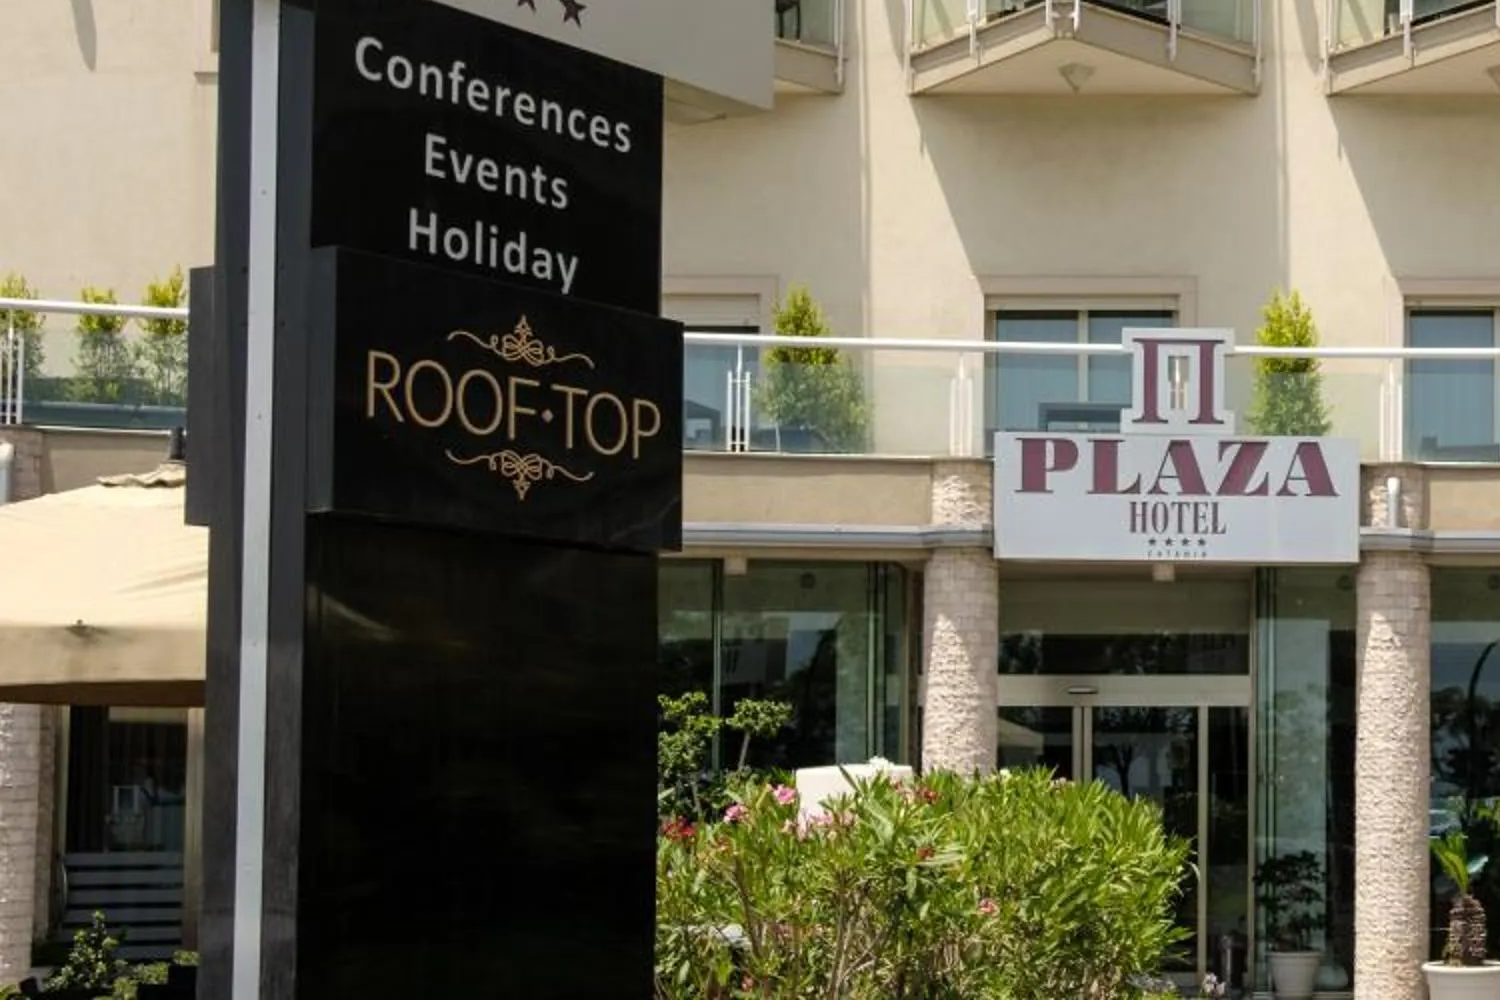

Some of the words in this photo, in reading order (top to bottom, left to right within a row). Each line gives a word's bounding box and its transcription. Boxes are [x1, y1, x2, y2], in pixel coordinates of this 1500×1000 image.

[354, 35, 633, 153] Conferences
[424, 133, 570, 210] Events
[408, 208, 580, 295] Holiday
[1014, 437, 1340, 497] PLAZA
[1129, 501, 1227, 534] HOTEL
